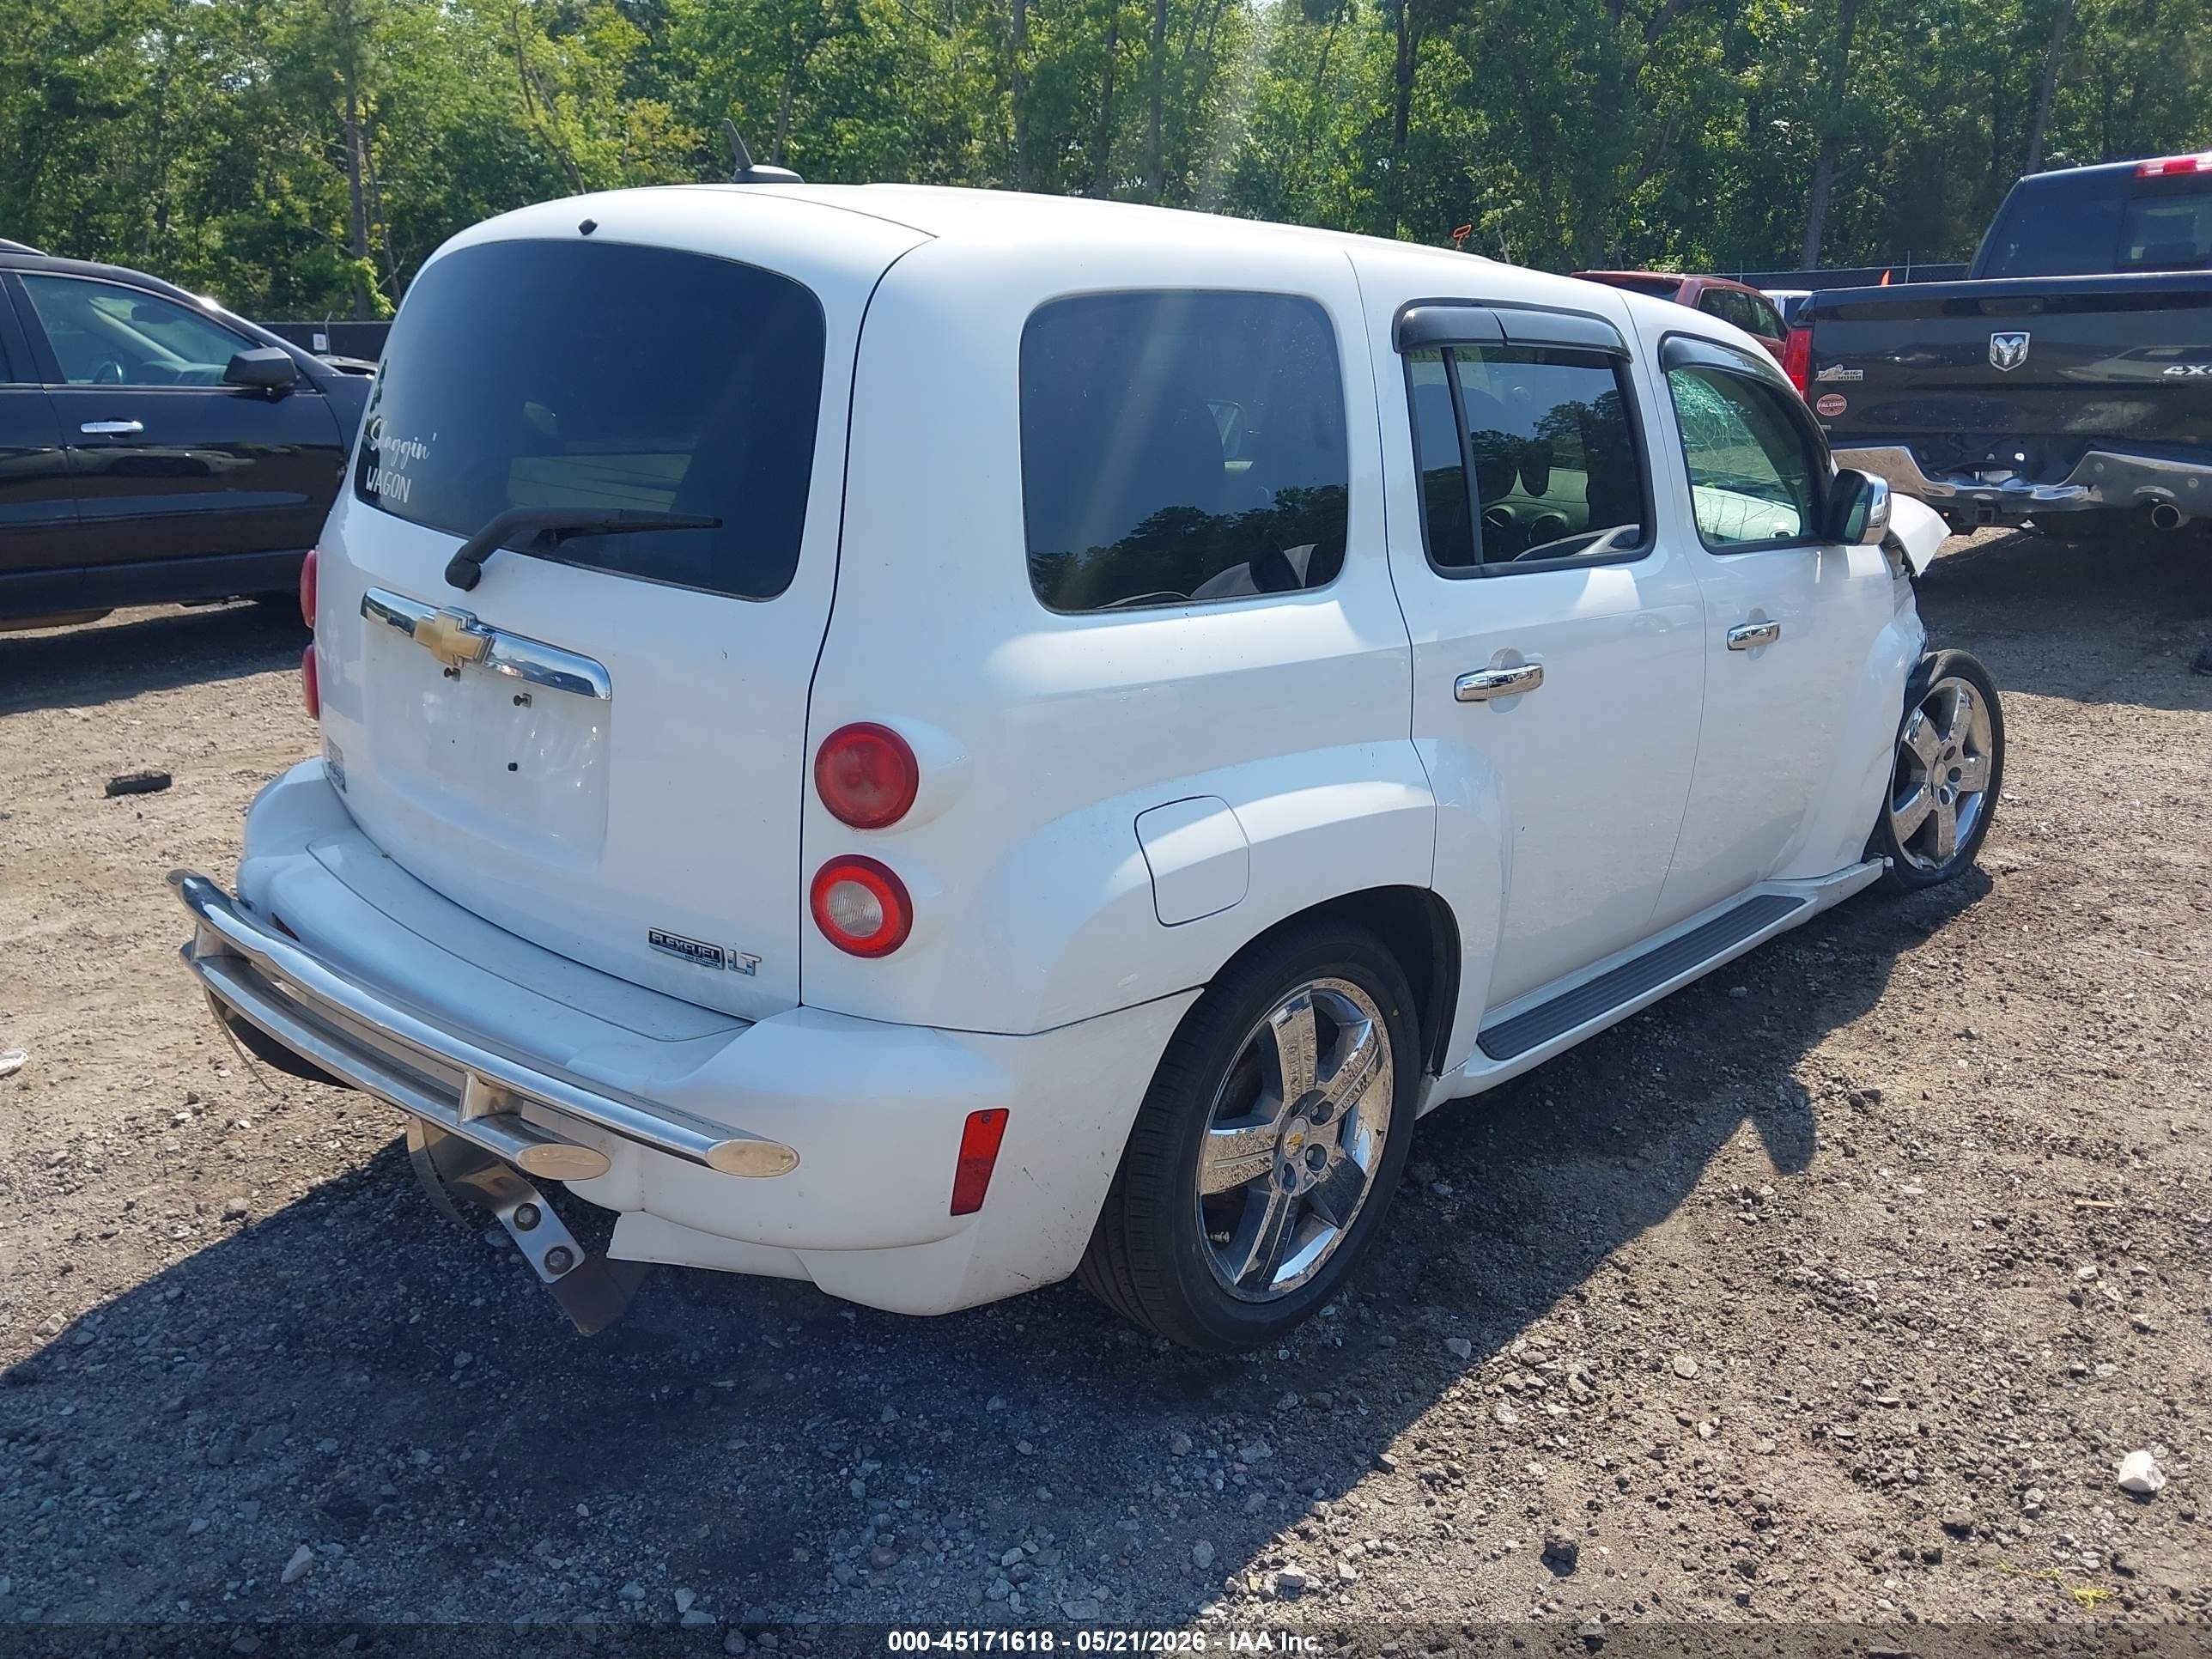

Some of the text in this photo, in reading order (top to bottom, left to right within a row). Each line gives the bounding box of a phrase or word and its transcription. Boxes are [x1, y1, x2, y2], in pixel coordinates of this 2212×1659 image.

[2163, 364, 2212, 376] 4X
[365, 465, 411, 504] WAGON
[652, 933, 720, 963] FLEXFUEL
[727, 949, 762, 976] LT
